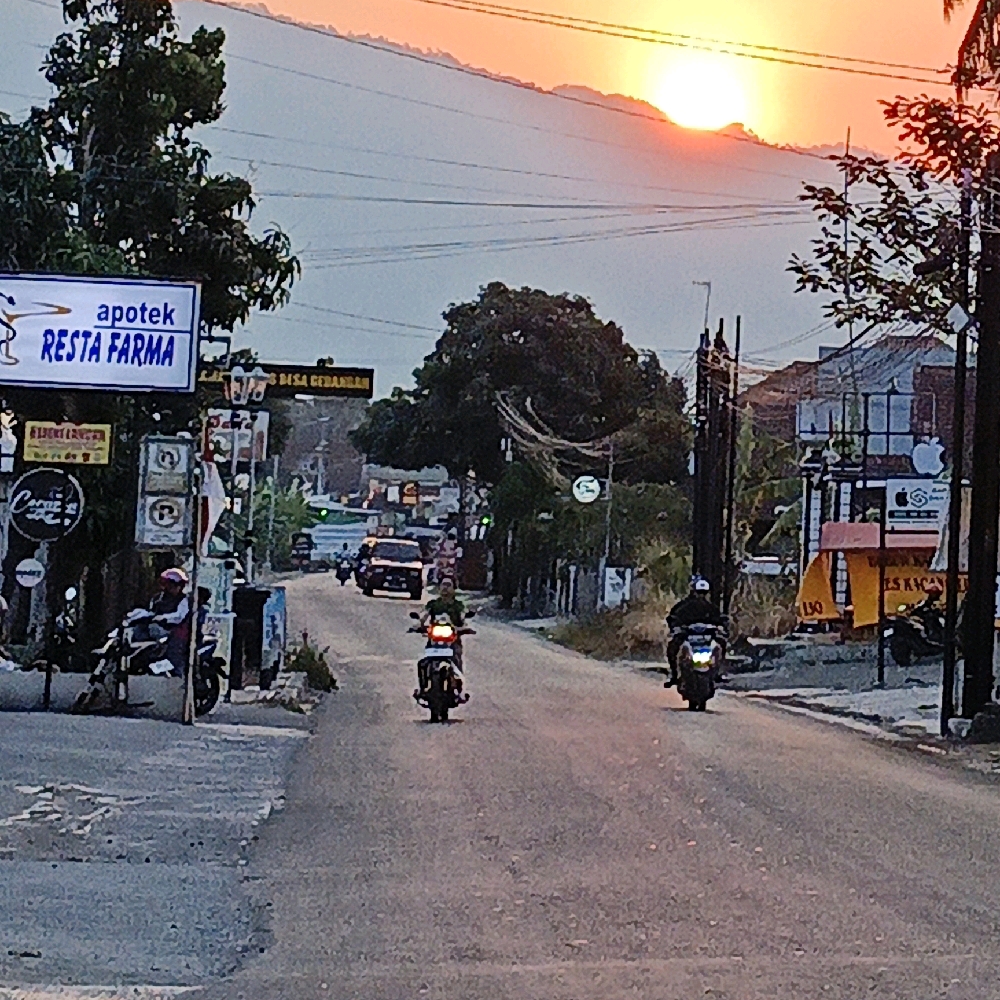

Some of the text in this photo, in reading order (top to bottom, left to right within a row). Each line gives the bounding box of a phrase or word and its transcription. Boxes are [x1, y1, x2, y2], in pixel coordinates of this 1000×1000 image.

[97, 302, 175, 328] apotek
[41, 328, 175, 367] RESTA FARMA
